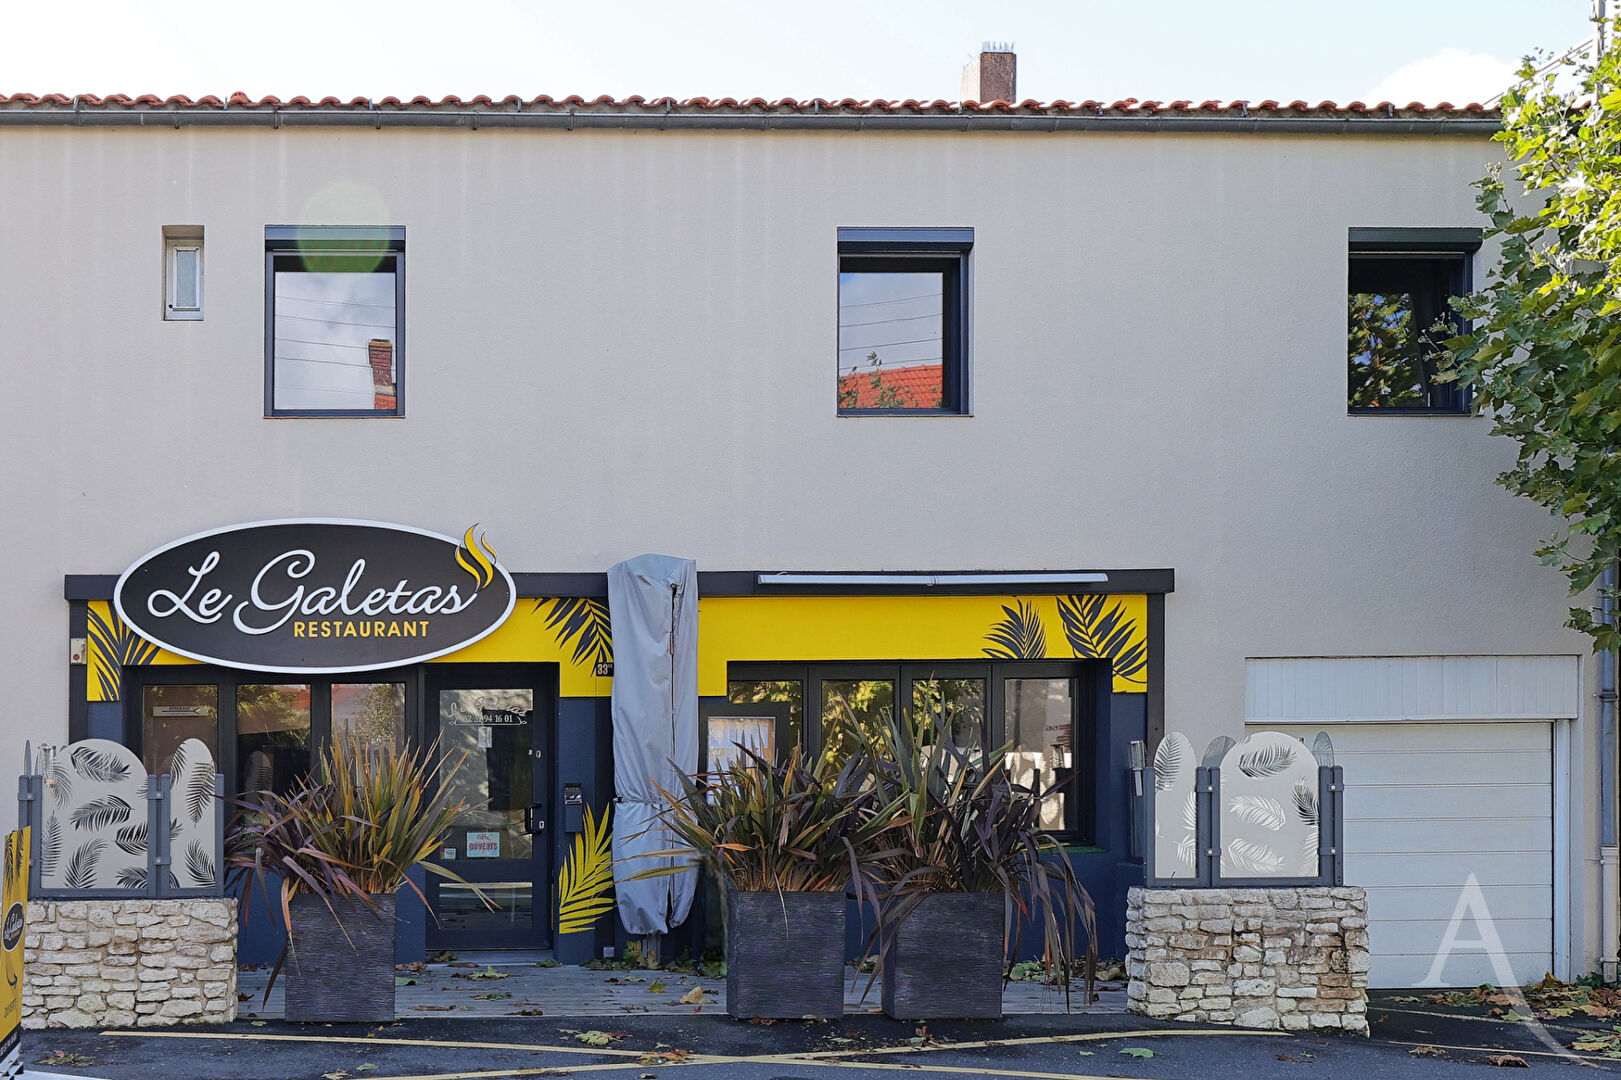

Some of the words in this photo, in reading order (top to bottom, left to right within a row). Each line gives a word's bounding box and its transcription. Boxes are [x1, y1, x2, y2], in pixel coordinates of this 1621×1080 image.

[147, 551, 233, 624] Le
[232, 549, 478, 635] Galetas
[293, 620, 430, 638] RESTAURANT
[483, 714, 493, 723] 94
[495, 714, 503, 723] 16
[504, 714, 514, 723] 01
